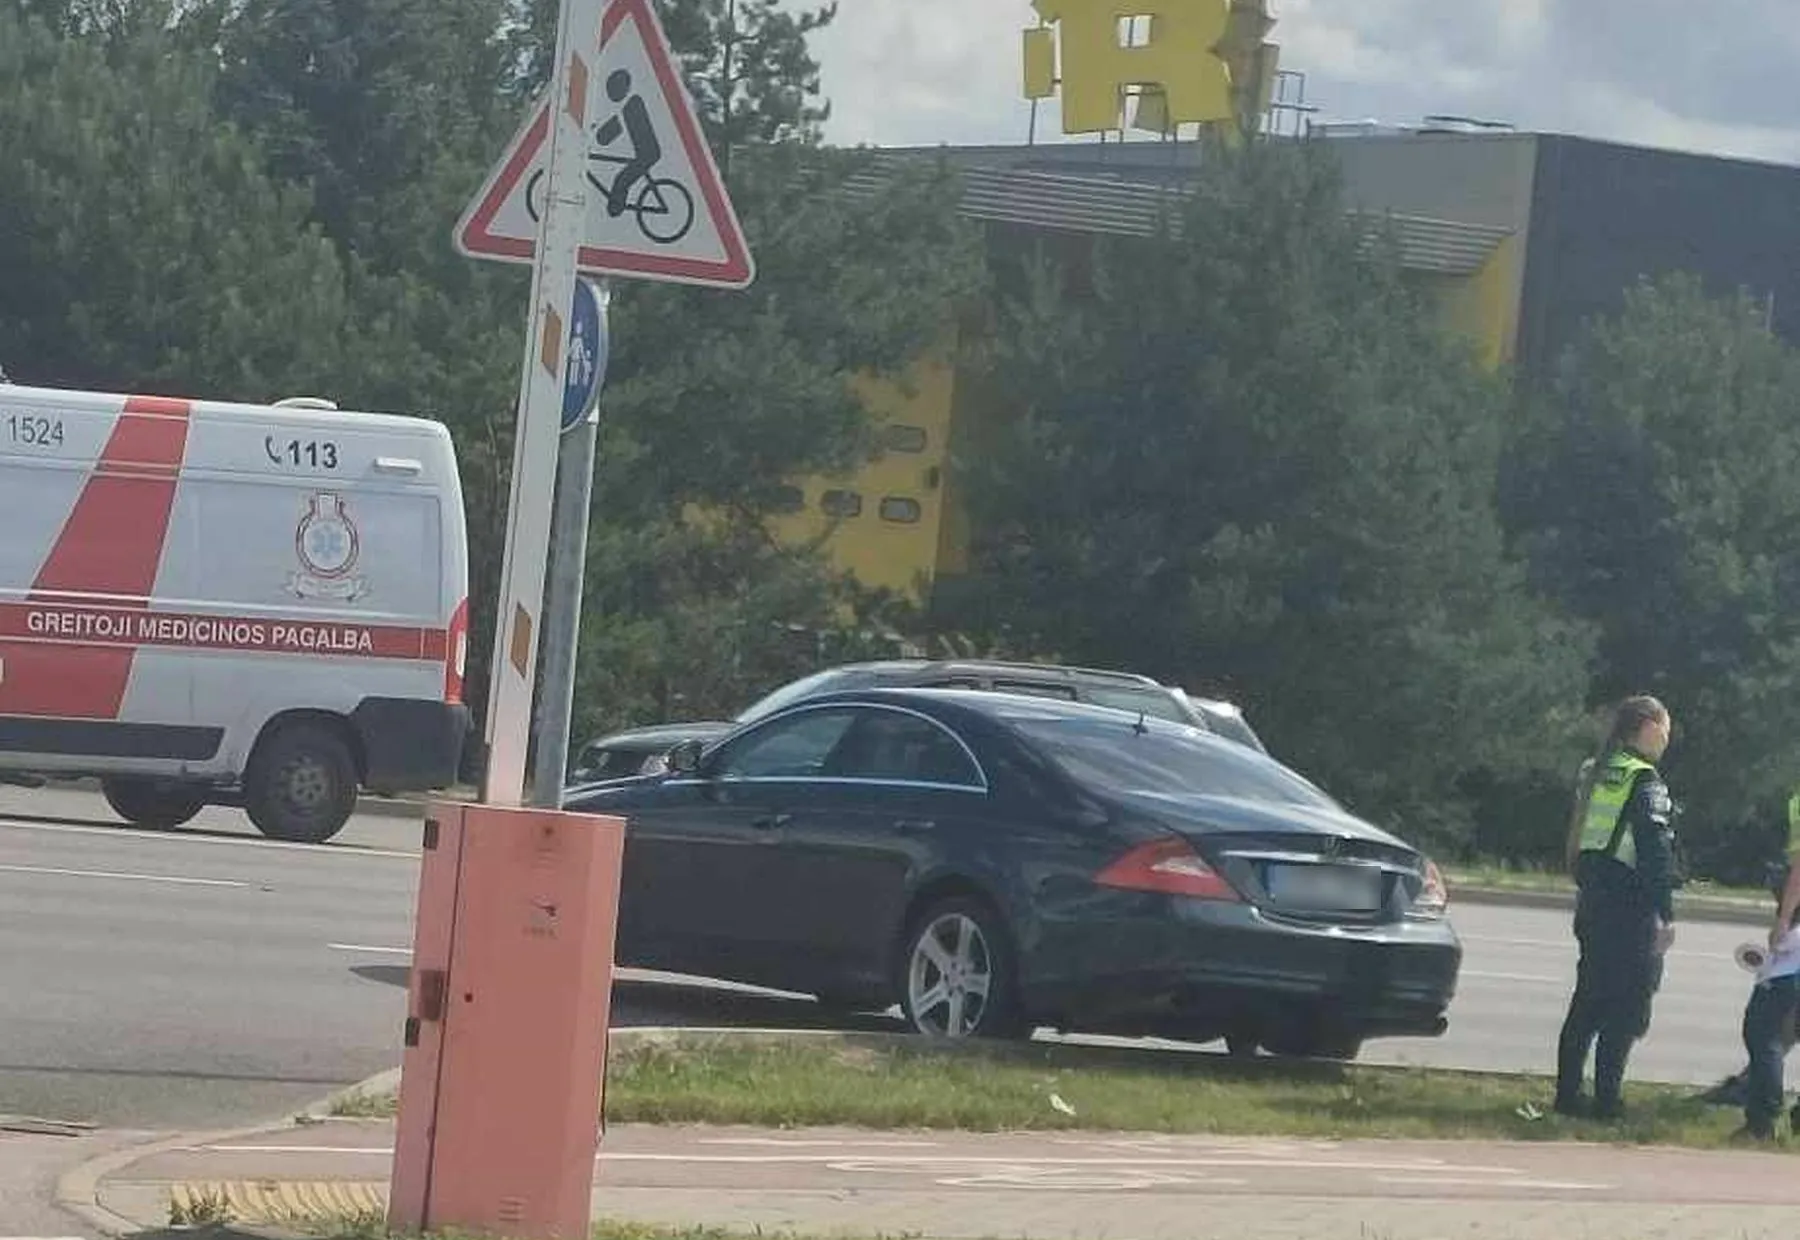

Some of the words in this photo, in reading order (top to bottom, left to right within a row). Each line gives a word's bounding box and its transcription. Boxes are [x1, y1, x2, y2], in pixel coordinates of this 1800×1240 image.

[8, 415, 65, 446] 1524
[287, 440, 339, 469] 113
[27, 611, 132, 637] GREITOJI
[138, 617, 265, 645] MEDICINOS
[271, 625, 373, 652] PAGALBA
